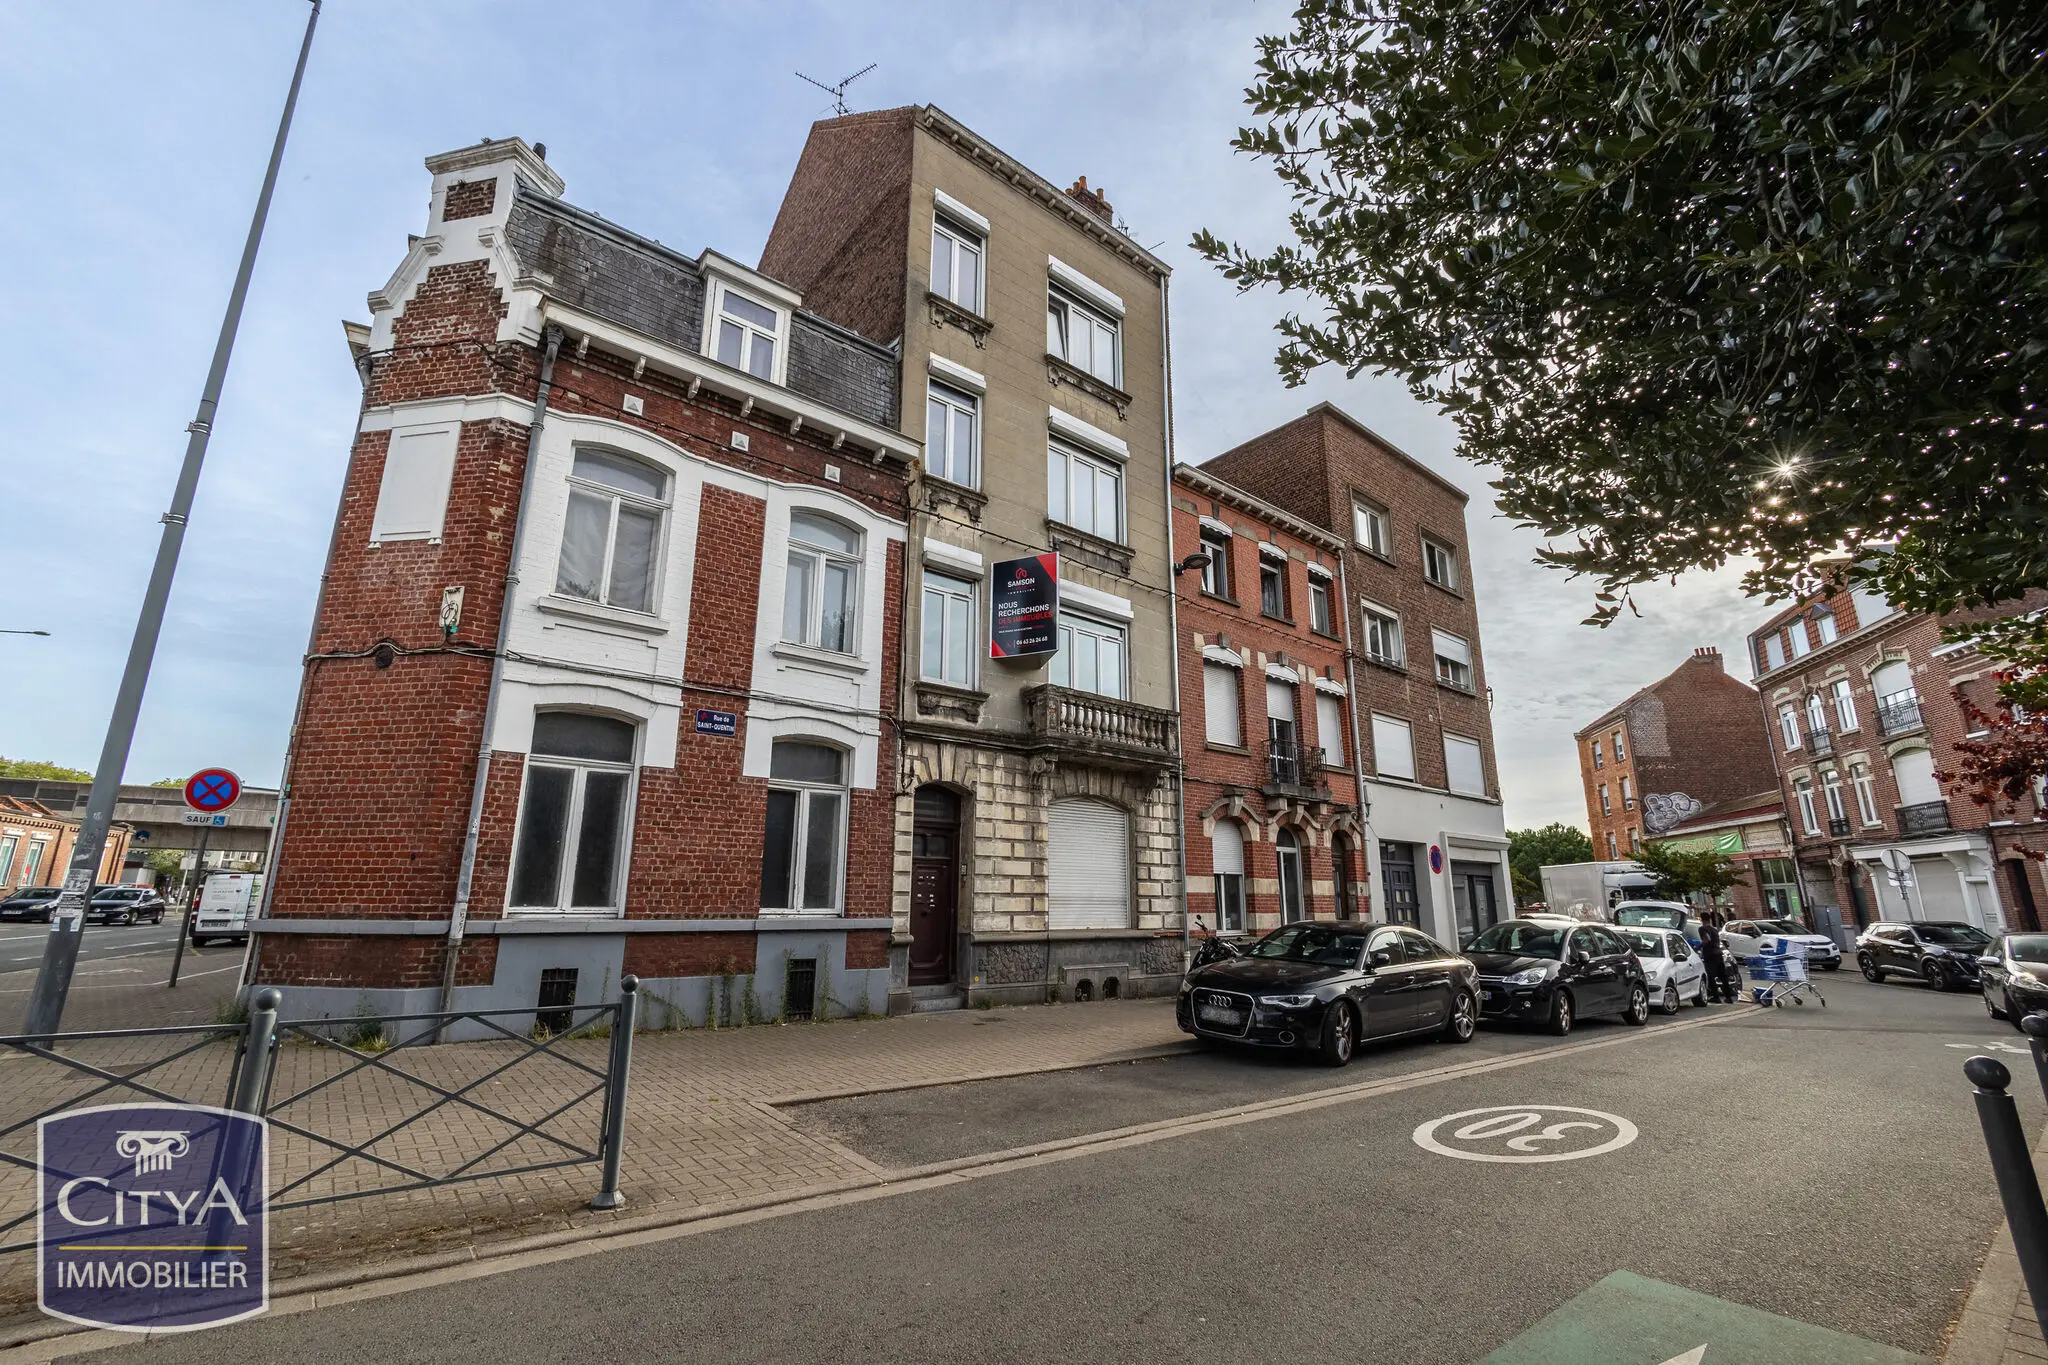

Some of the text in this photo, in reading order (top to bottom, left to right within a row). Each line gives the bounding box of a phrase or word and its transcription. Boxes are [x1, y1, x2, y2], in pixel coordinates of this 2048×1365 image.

[1007, 578, 1035, 588] SAMSON
[998, 601, 1018, 610] NOUS
[998, 604, 1050, 617] RECHERCHONS
[713, 714, 722, 722] Rue
[697, 722, 735, 732] SAINT-QUENTIN
[186, 815, 212, 824] SAUF
[1454, 1112, 1603, 1152] 30
